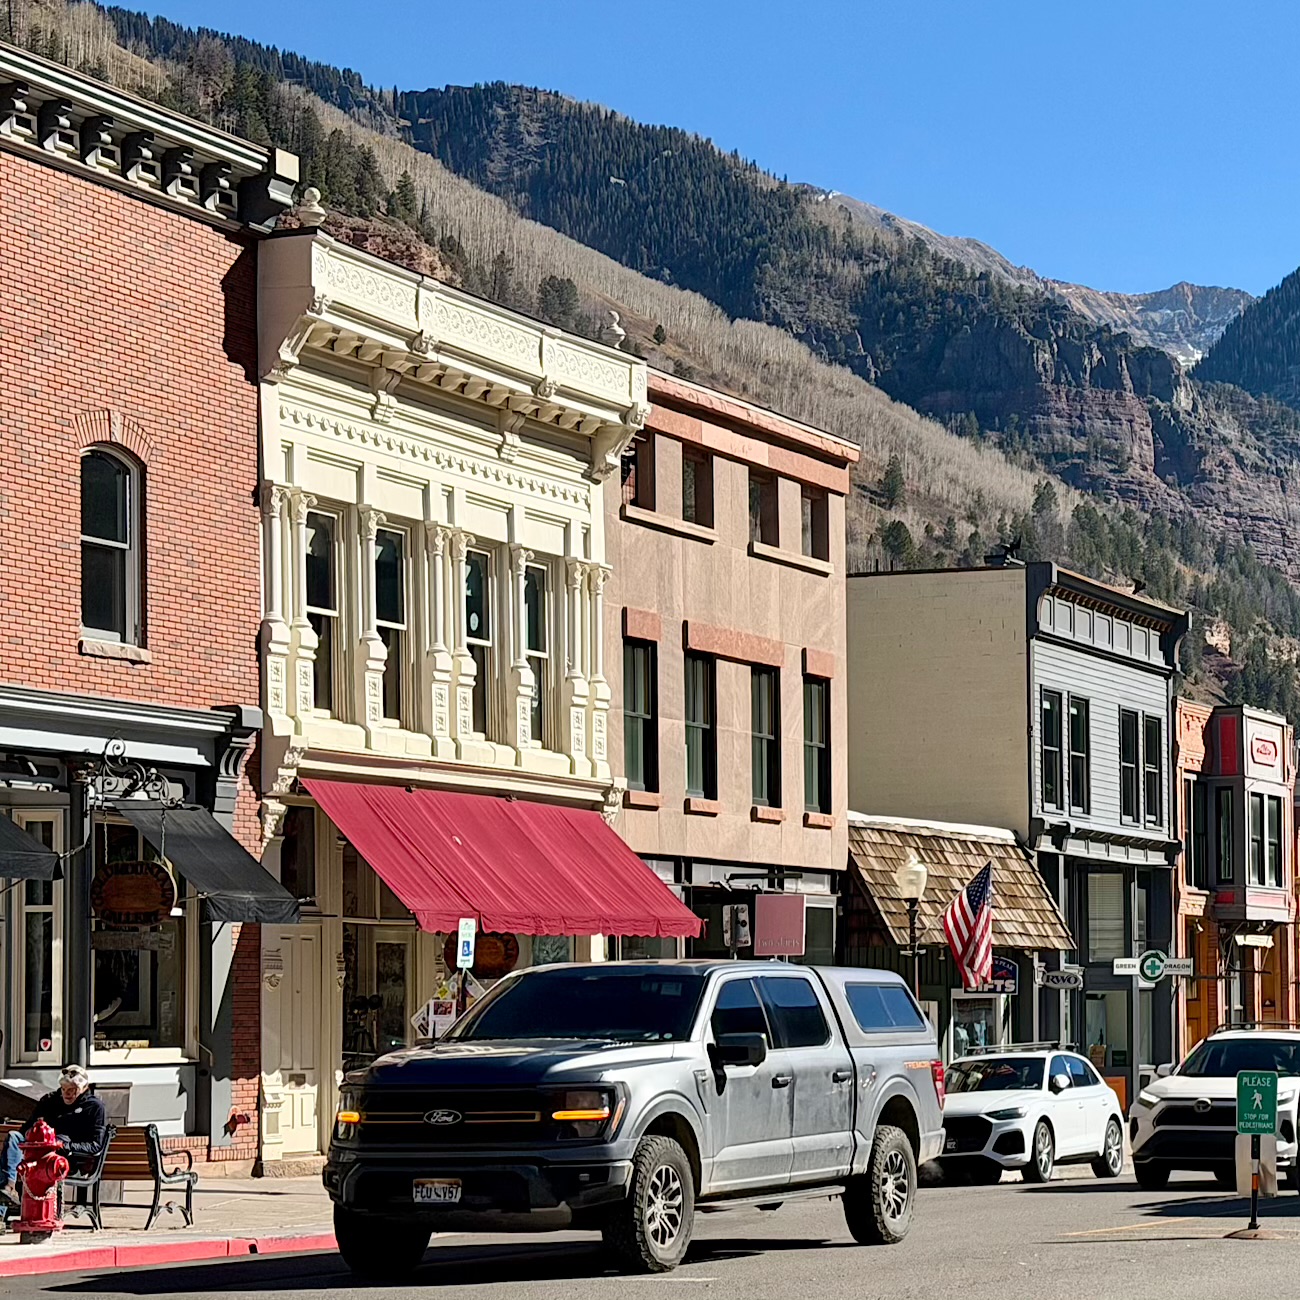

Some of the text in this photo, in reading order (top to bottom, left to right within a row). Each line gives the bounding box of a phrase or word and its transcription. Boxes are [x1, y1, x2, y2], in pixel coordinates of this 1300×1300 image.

[1045, 974, 1078, 985] RWO
[1242, 1077, 1271, 1087] PLEASE
[430, 1111, 454, 1122] Ford
[1239, 1121, 1273, 1129] PEDESTRIANS
